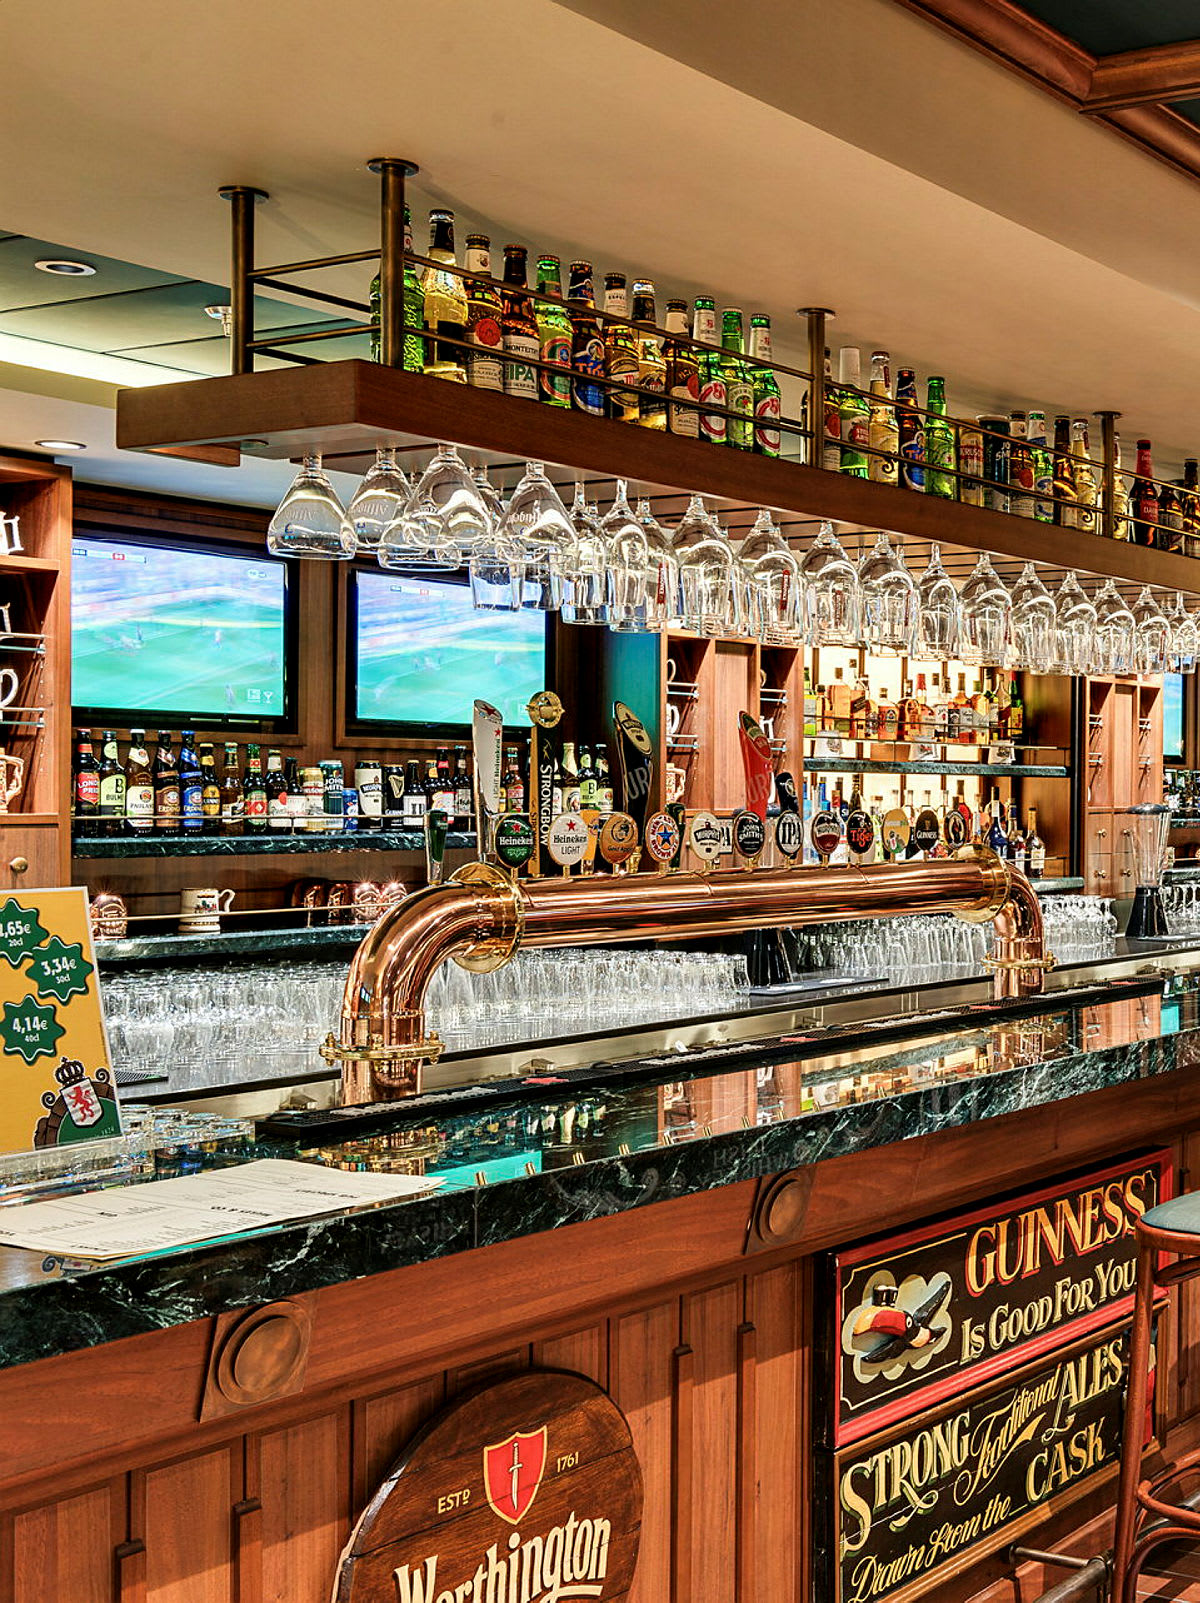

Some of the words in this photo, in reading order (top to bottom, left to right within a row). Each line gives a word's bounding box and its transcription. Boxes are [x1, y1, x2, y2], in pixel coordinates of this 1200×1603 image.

[508, 363, 535, 383] IPA
[540, 764, 553, 846] STRONGBOW
[499, 836, 533, 846] Heineken
[553, 834, 588, 844] Heineken
[781, 822, 801, 845] IPA
[561, 846, 581, 855] LIGHT
[8, 938, 24, 947] 20cl
[41, 957, 77, 976] 3,34€
[12, 1016, 48, 1034] 4,14€
[965, 1174, 1146, 1298] GUINNESS
[839, 1409, 972, 1557] STRONG
[953, 1361, 1063, 1507] Traditional
[1041, 1338, 1124, 1443] ALES
[556, 1451, 580, 1473] 1761
[849, 1543, 926, 1603] Drawn
[922, 1519, 981, 1568] from
[980, 1494, 1012, 1533] the
[1025, 1416, 1106, 1502] CASK
[394, 1511, 612, 1603] Wthington
